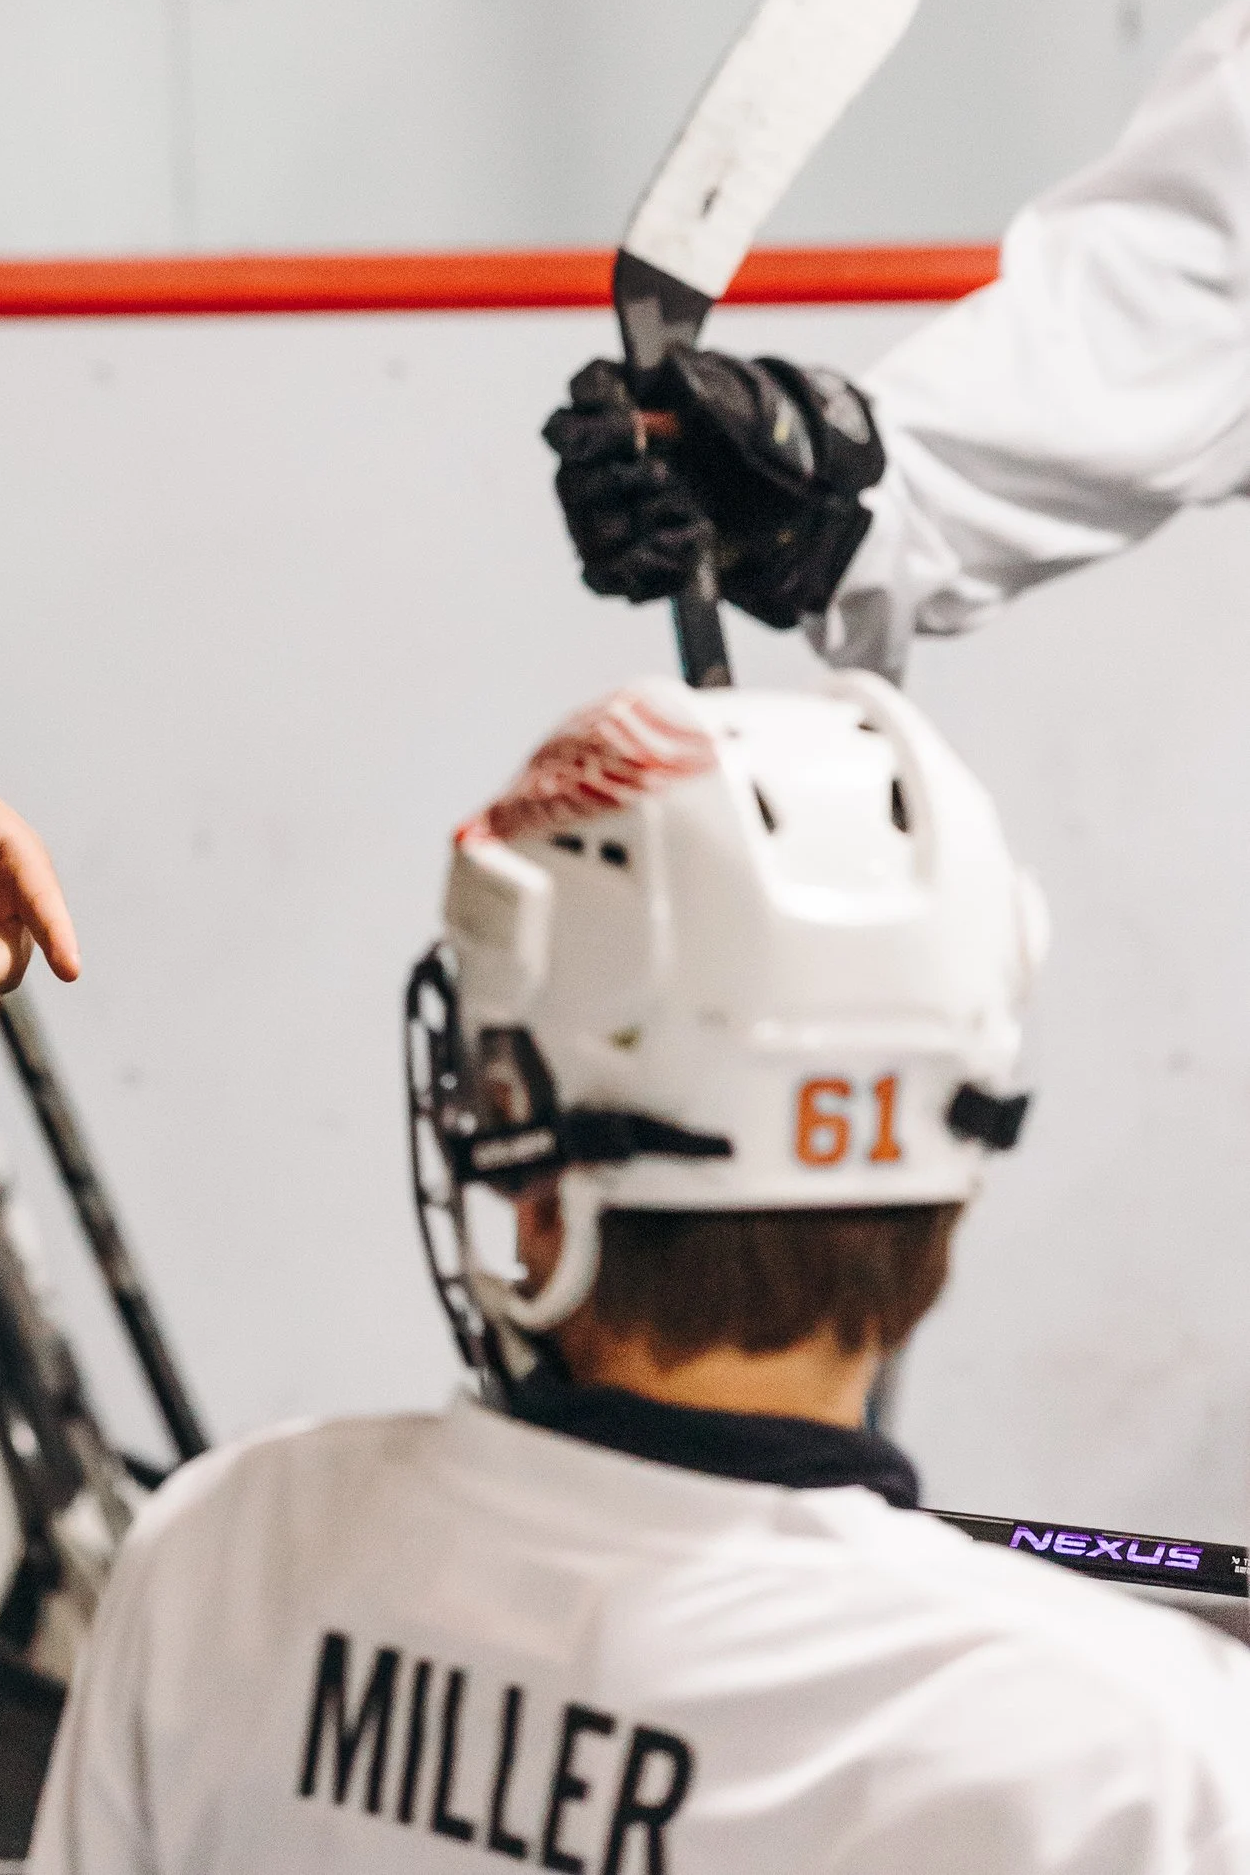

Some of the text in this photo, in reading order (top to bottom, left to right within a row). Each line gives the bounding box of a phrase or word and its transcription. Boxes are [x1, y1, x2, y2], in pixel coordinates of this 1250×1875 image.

[795, 1075, 902, 1167] 61
[1008, 1525, 1204, 1570] NEXUS
[297, 1629, 697, 1875] MILLER
